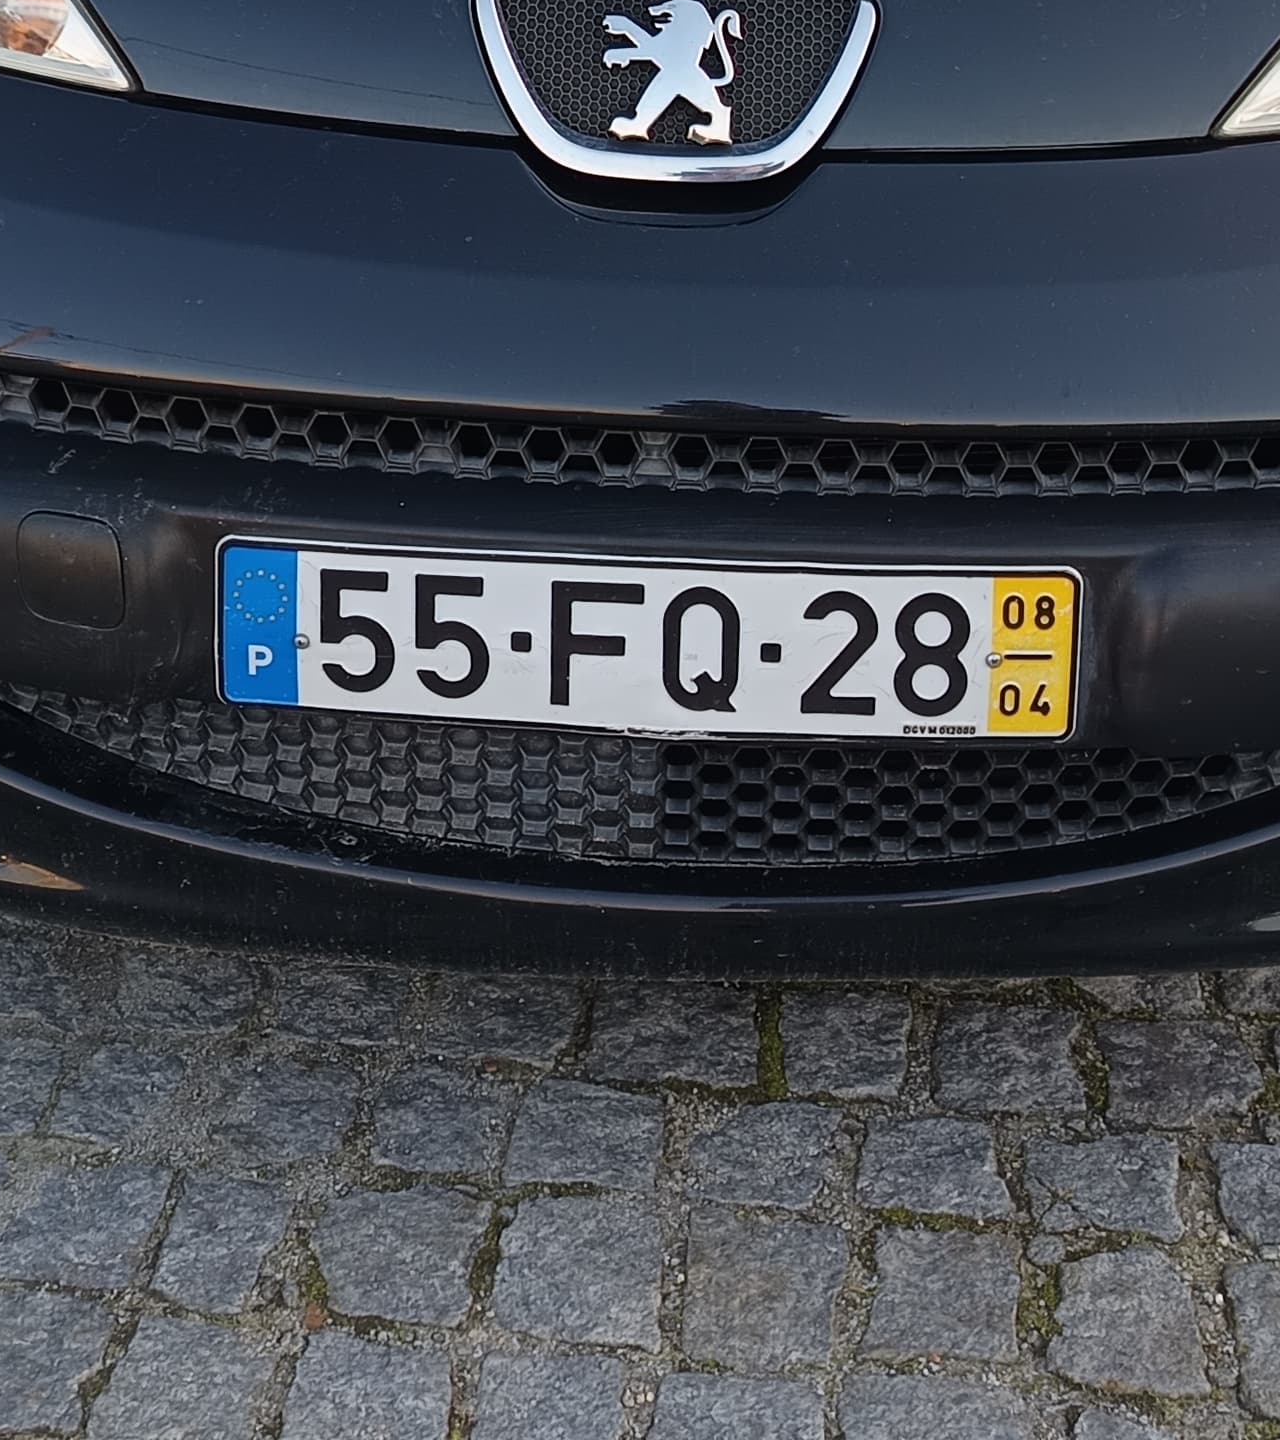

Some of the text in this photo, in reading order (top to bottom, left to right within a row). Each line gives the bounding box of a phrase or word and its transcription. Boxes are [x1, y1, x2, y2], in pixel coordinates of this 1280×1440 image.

[1002, 594, 1056, 631] 08
[247, 644, 274, 676] P
[998, 683, 1052, 717] 04
